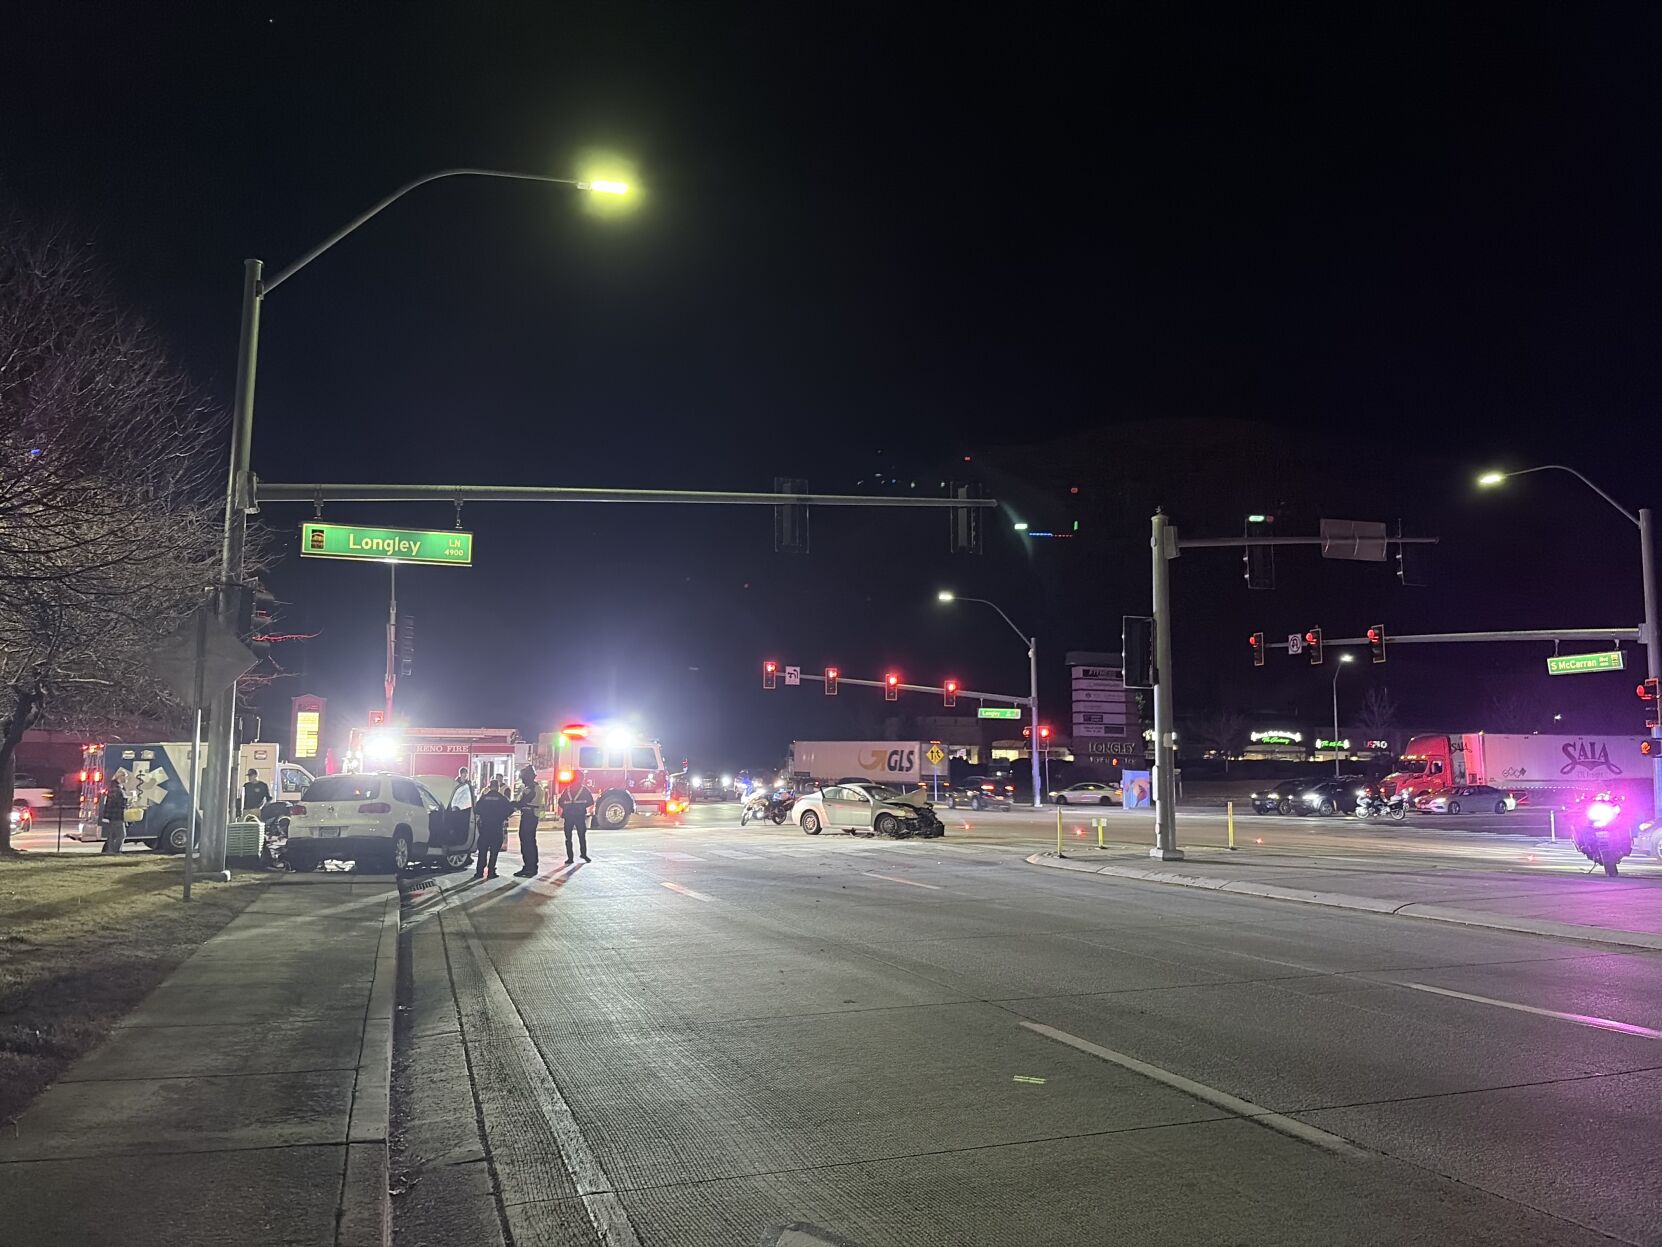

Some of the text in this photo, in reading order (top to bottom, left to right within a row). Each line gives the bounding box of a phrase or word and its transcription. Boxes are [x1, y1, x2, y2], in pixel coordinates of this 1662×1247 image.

[349, 533, 461, 556] Longley LN
[1551, 661, 1557, 670] S
[1559, 659, 1597, 669] McCarran
[416, 745, 469, 753] RENO FIRE
[1089, 742, 1136, 754] LONGLEY
[887, 749, 915, 772] GLS
[1560, 741, 1623, 775] SAIA
